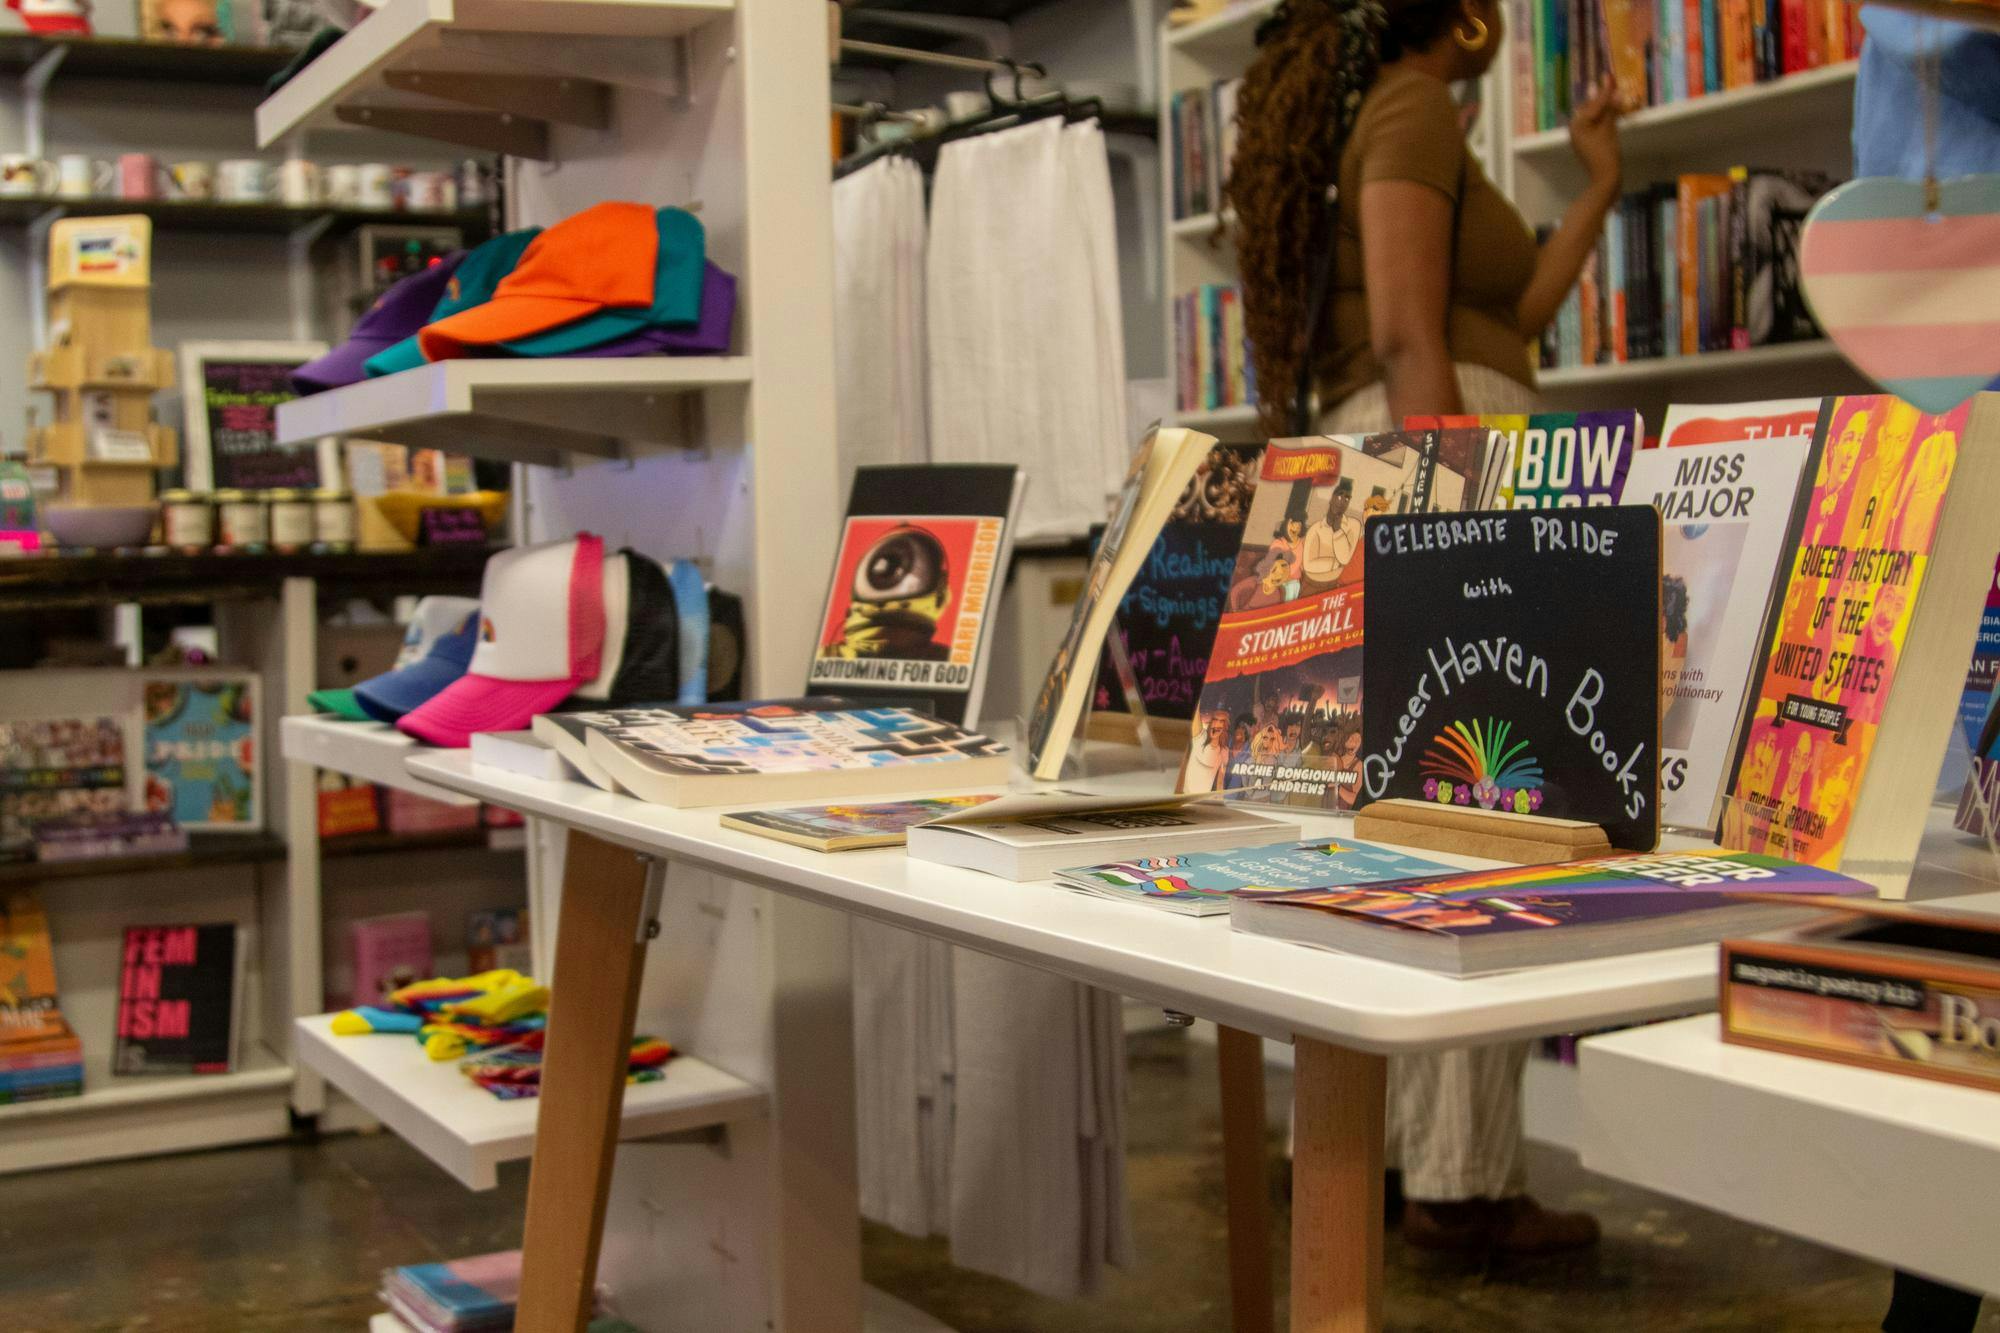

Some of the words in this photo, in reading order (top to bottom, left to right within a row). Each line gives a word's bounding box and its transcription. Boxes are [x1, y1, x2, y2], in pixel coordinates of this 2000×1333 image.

[1273, 455, 1310, 476] HISTORY
[1306, 453, 1337, 473] COMICS
[1502, 425, 1626, 488] BOW
[1674, 453, 1745, 486] MISS
[1652, 487, 1754, 519] MAJOR
[1861, 496, 1877, 530] A
[1374, 518, 1507, 554] CELEBRATE
[1531, 516, 1618, 555] PRIDE
[962, 519, 1000, 613] MORRISON
[1801, 544, 1847, 580] QUEER
[1851, 547, 1917, 586] HISTORY
[1322, 592, 1348, 611] THE
[1463, 577, 1512, 599] with
[1138, 586, 1218, 629] Signings
[1813, 597, 1836, 629] OF
[1838, 598, 1870, 636] THE
[1238, 608, 1354, 656] STONEWALL
[1226, 653, 1268, 668] MAKING
[1282, 642, 1316, 657] STAND
[1319, 636, 1342, 648] FOR
[1774, 642, 1822, 682] UNITED
[1824, 651, 1885, 694] STATES
[814, 660, 899, 680] BOTTOMING
[900, 663, 932, 682] FOR
[935, 664, 969, 684] GOD
[1680, 668, 1704, 681] with
[1143, 680, 1194, 701] 2024
[1428, 637, 1548, 698] Haven
[1565, 668, 1646, 820] Books
[1786, 701, 1799, 715] FOR
[1800, 704, 1817, 720] YOUNG
[1817, 707, 1842, 727] PEOPLE
[1232, 763, 1274, 777] ARCHIE
[1277, 766, 1357, 784] BONGIOVANNI
[1270, 780, 1326, 795] ANDREWS
[124, 926, 197, 964] FEM
[116, 1000, 191, 1039] ISM
